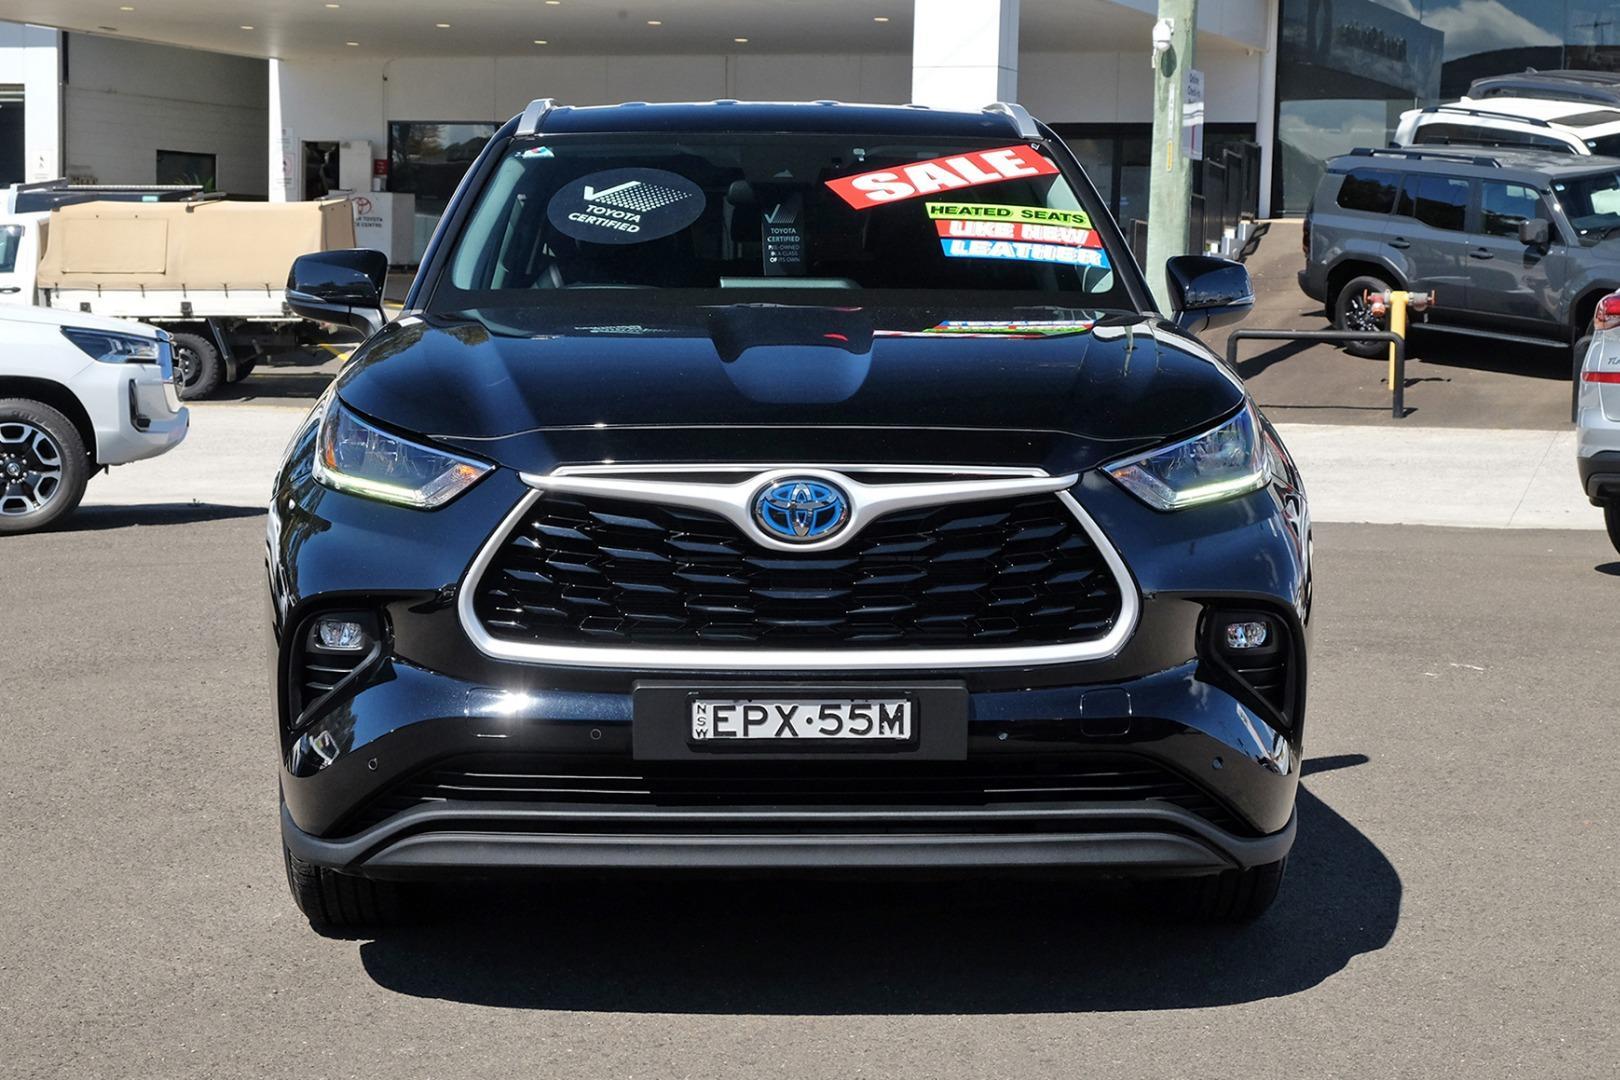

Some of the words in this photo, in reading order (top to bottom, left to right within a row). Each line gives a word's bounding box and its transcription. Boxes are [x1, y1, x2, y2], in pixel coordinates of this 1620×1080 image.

[851, 150, 1039, 201] SALE
[568, 212, 640, 233] CERTIFIED
[586, 204, 641, 223] TOYOTA
[930, 206, 1011, 217] HEATED
[1020, 208, 1084, 223] SEATS
[950, 239, 1101, 265] LEATHER
[696, 704, 708, 738] NSW
